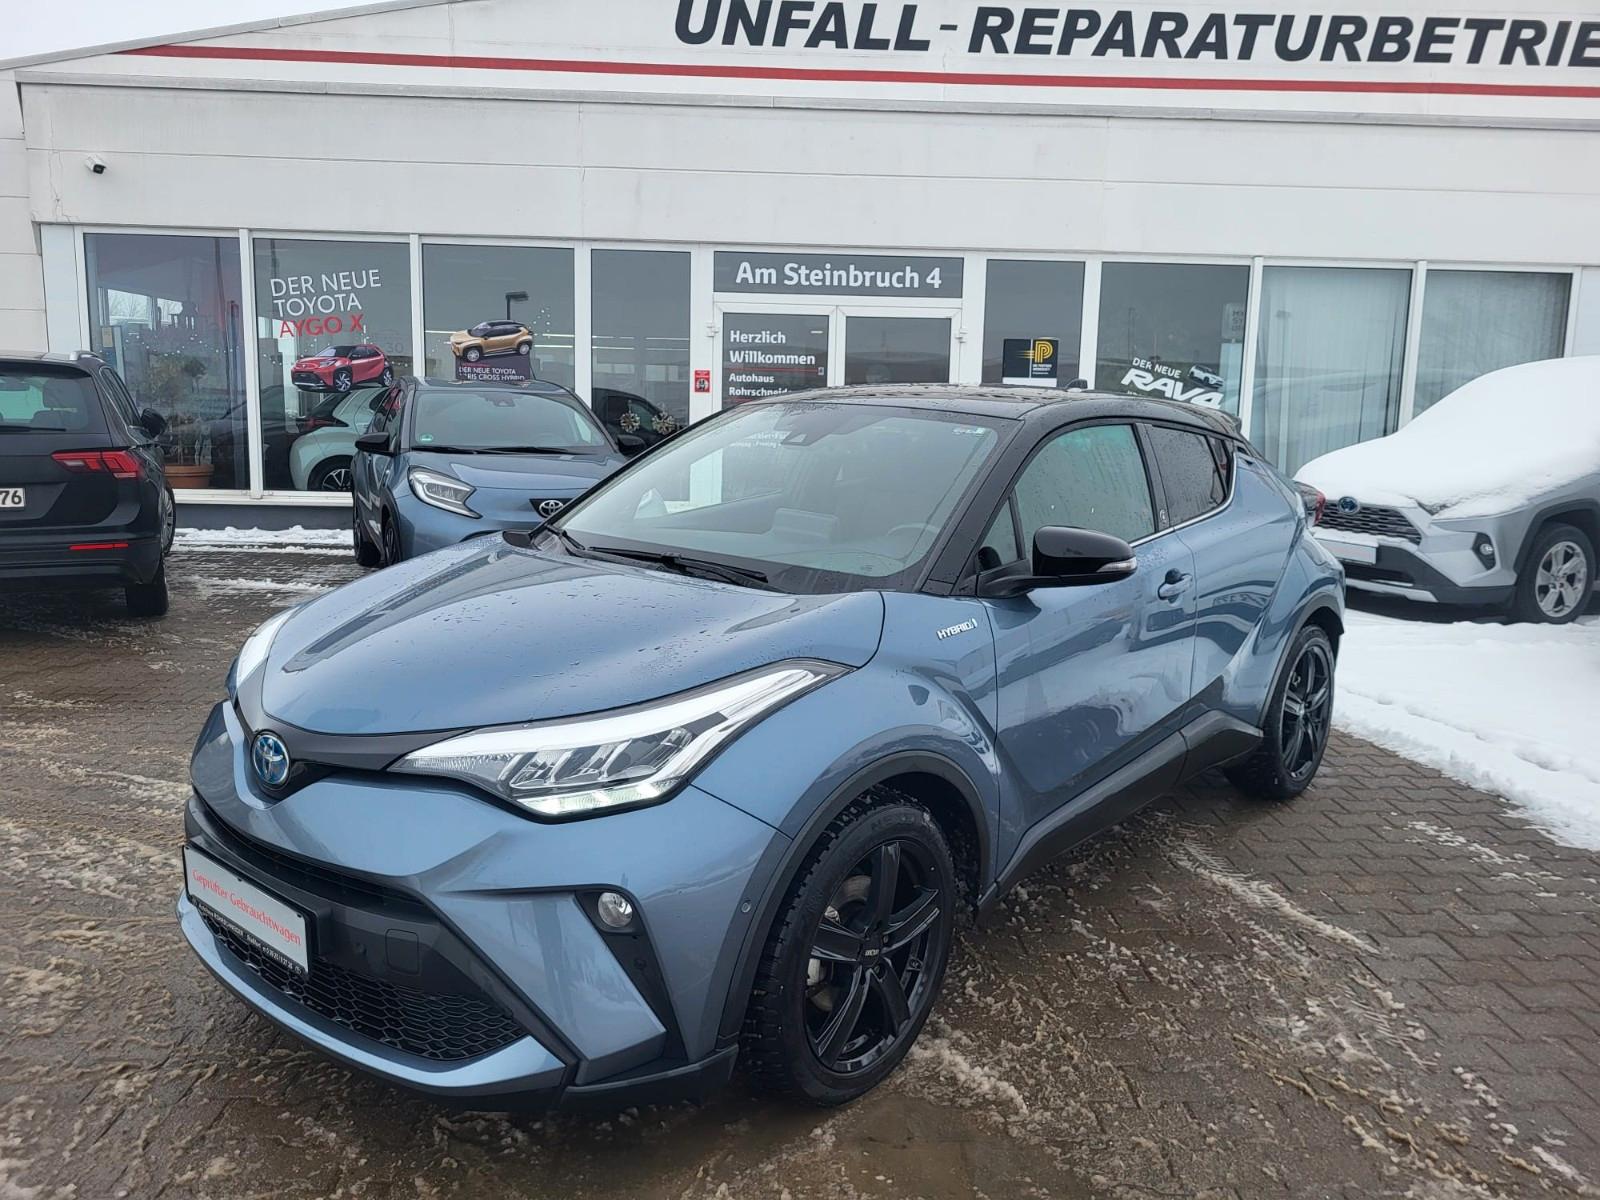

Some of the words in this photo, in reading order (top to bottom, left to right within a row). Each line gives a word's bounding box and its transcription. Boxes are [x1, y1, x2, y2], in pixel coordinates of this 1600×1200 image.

[270, 275, 315, 297] DER
[321, 269, 382, 292] NEUE
[735, 261, 777, 285] Am
[783, 262, 919, 289] Steinbruch
[925, 267, 942, 289] 4
[273, 292, 362, 318] TOYOTA
[280, 315, 343, 338] AYGO
[349, 313, 364, 333] X
[729, 330, 786, 344] Herzlich
[729, 350, 816, 365] Willkommen
[1132, 357, 1152, 370] DER
[1154, 363, 1182, 379] NEUE
[729, 373, 775, 383] Autohaus
[1120, 367, 1224, 410] RAV4
[729, 386, 792, 397] Rohrschneid
[0, 490, 22, 505] 76
[936, 619, 974, 640] HYBRID
[230, 892, 302, 946] Gebrauchtwagen
